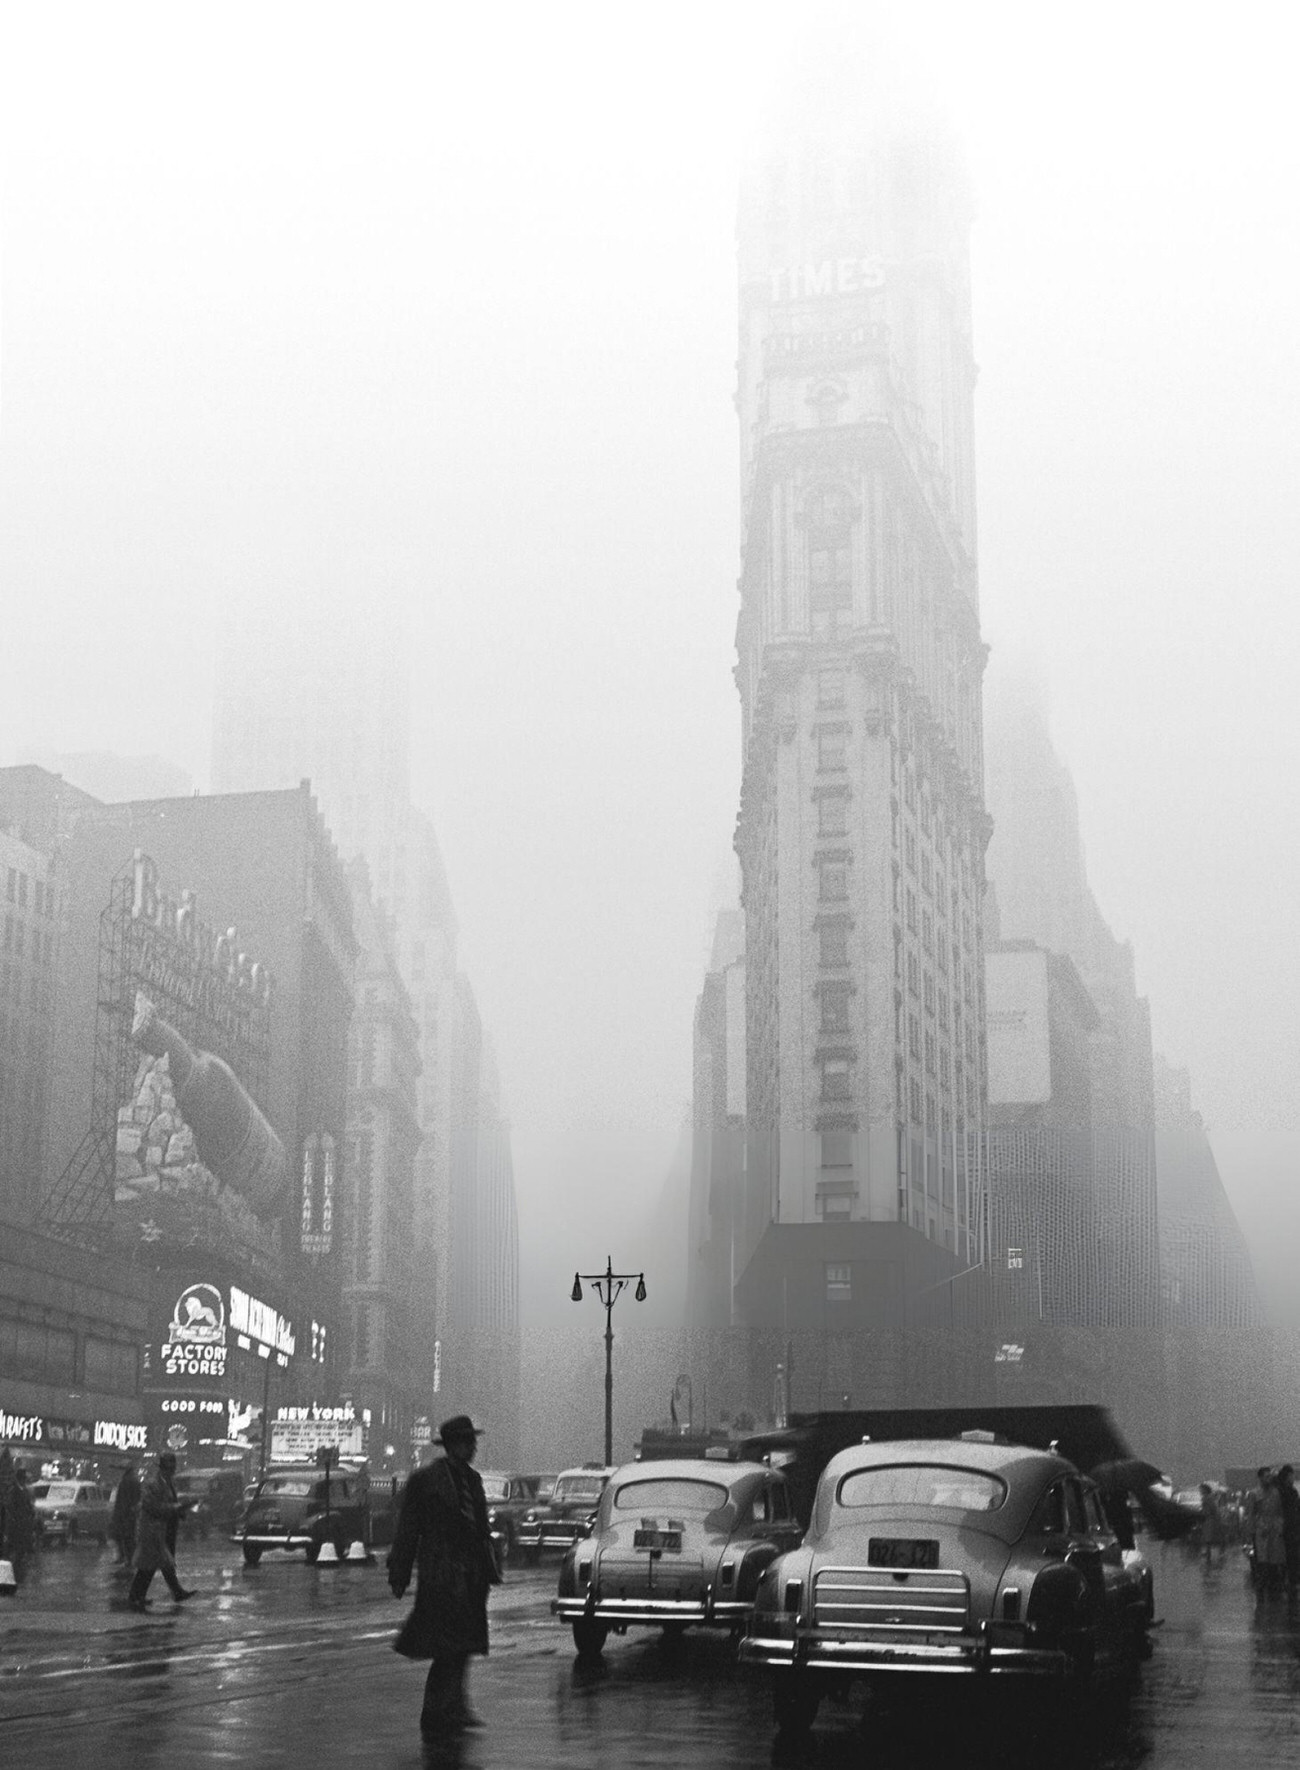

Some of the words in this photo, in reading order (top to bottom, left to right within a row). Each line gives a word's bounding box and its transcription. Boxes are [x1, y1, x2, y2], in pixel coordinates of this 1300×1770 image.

[768, 255, 886, 302] TIMES
[161, 1344, 228, 1361] FACTORY
[165, 1359, 225, 1376] STORES
[161, 1400, 196, 1412] GOOD
[199, 1401, 224, 1414] FOOD
[278, 1407, 310, 1421] NEW
[312, 1406, 355, 1421] YORK
